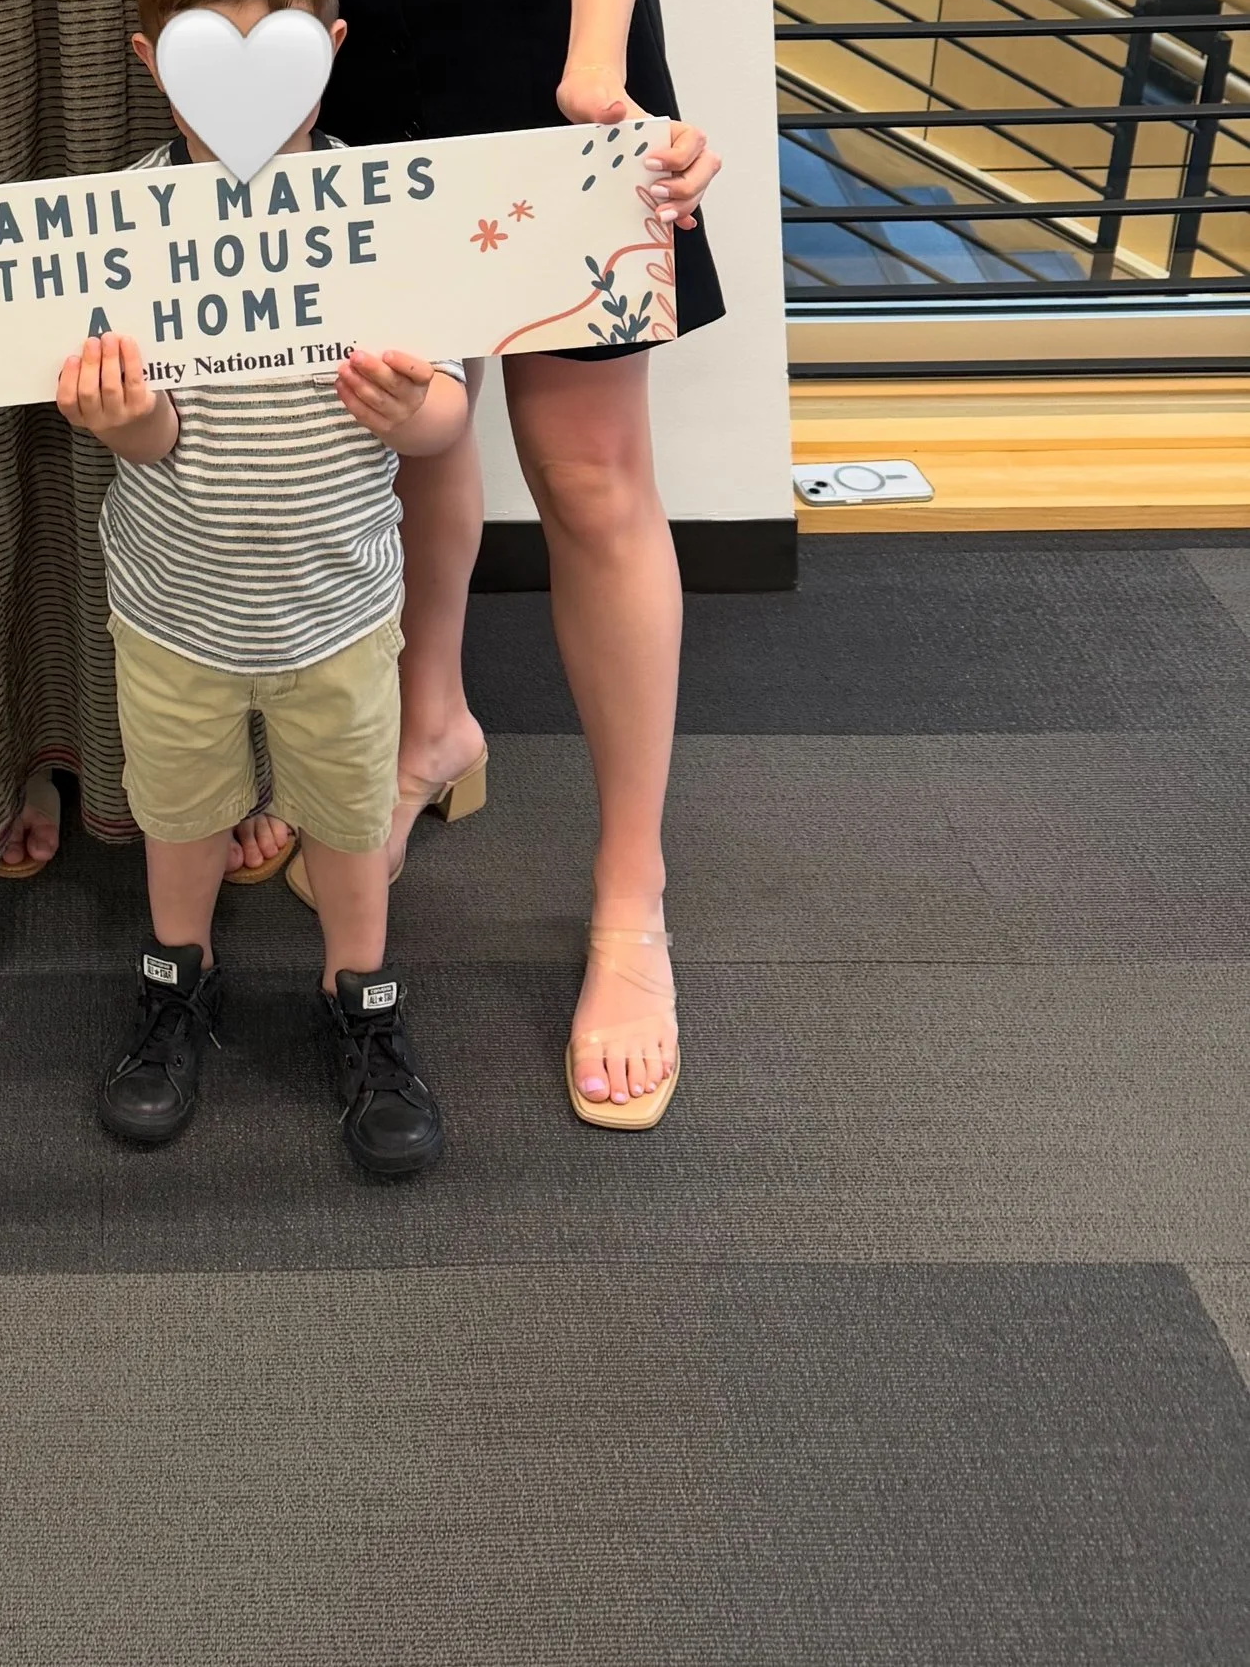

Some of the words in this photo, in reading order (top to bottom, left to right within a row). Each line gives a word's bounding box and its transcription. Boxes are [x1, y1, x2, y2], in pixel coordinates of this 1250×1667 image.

[216, 157, 435, 221] MAKES
[169, 220, 377, 283] HOUSE
[88, 306, 113, 338] A
[152, 283, 322, 342] HOME
[142, 361, 186, 384] elity
[194, 347, 293, 376] National
[300, 341, 355, 364] Title
